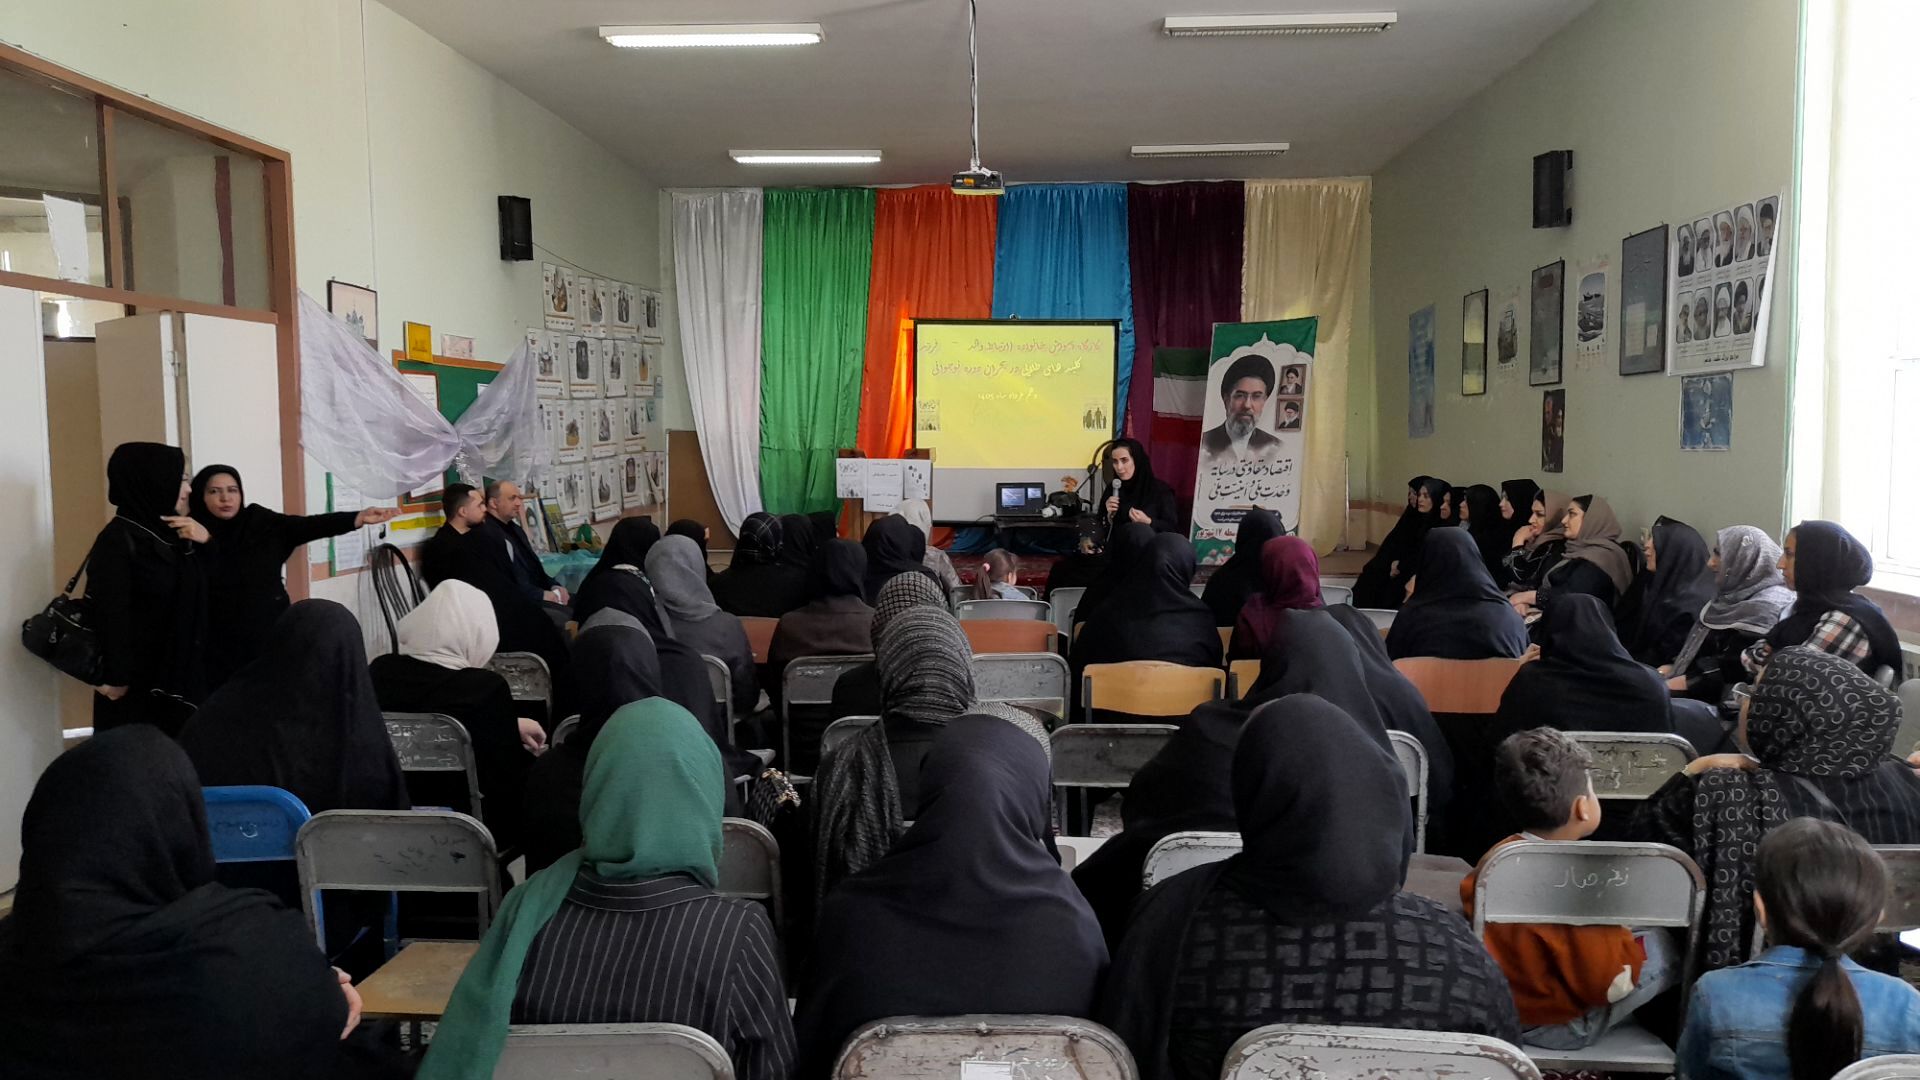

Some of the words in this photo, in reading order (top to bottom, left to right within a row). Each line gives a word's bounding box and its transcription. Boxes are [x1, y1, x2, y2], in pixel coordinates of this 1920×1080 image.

[1210, 461, 1228, 476] سایه
[1226, 465, 1237, 476] در
[1235, 459, 1266, 478] مقاومتی
[1262, 458, 1293, 477] اقتصاد
